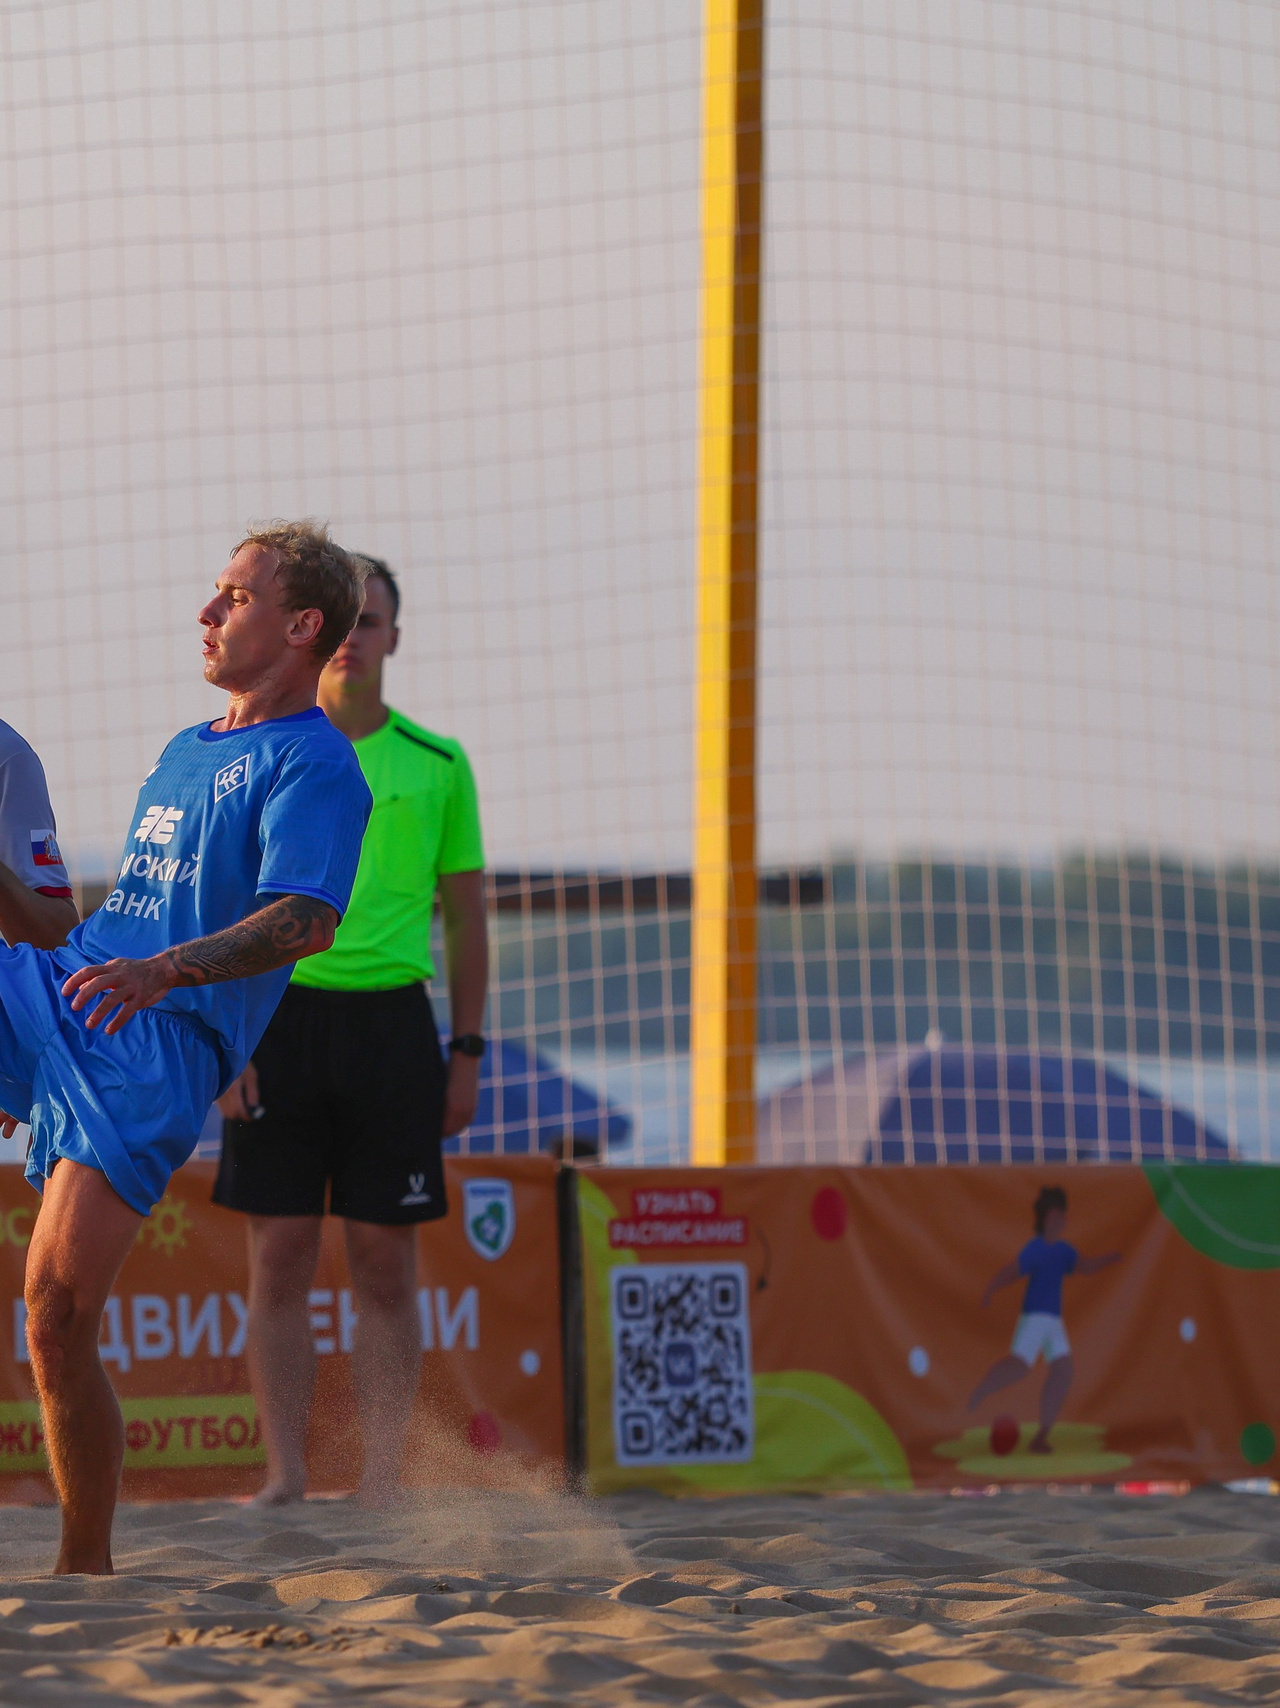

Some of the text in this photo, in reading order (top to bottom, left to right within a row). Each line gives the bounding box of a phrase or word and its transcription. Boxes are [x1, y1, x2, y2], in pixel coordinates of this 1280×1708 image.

[99, 888, 166, 921] анк
[634, 1189, 717, 1217] УЗНАТЬ
[611, 1219, 745, 1245] РАСПИСАНИЕ
